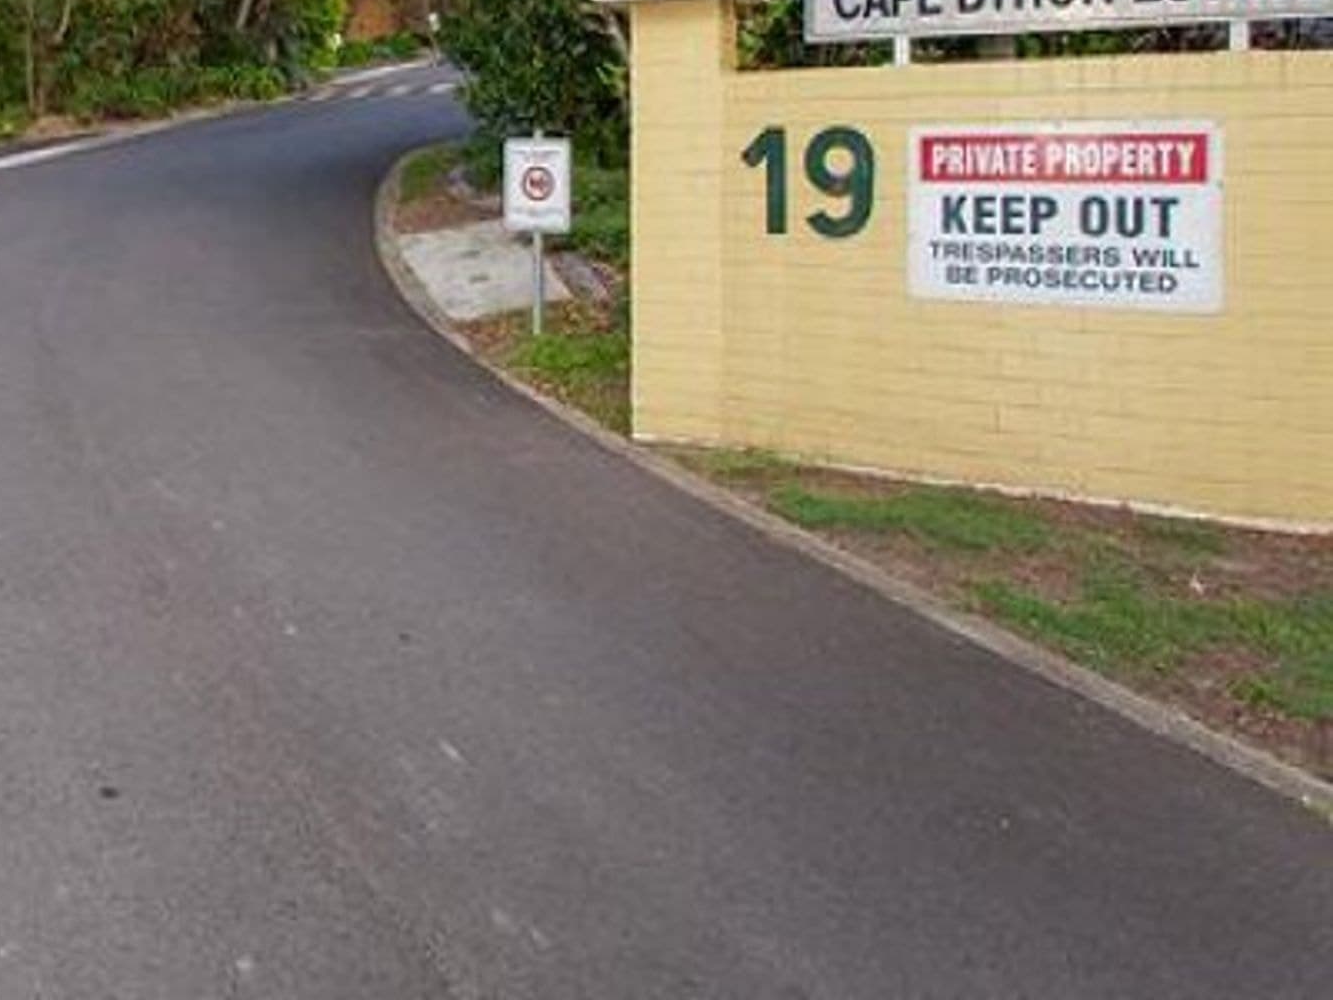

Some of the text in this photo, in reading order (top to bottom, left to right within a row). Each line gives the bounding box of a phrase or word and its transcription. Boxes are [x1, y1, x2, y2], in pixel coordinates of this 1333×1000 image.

[931, 140, 1198, 179] PRIVATE PROPERTY
[741, 126, 876, 239] 19
[941, 195, 1181, 239] KEEP OUT
[929, 242, 1201, 270] TRESPASSERS WILL
[945, 266, 1179, 294] BE PROSECUTED
